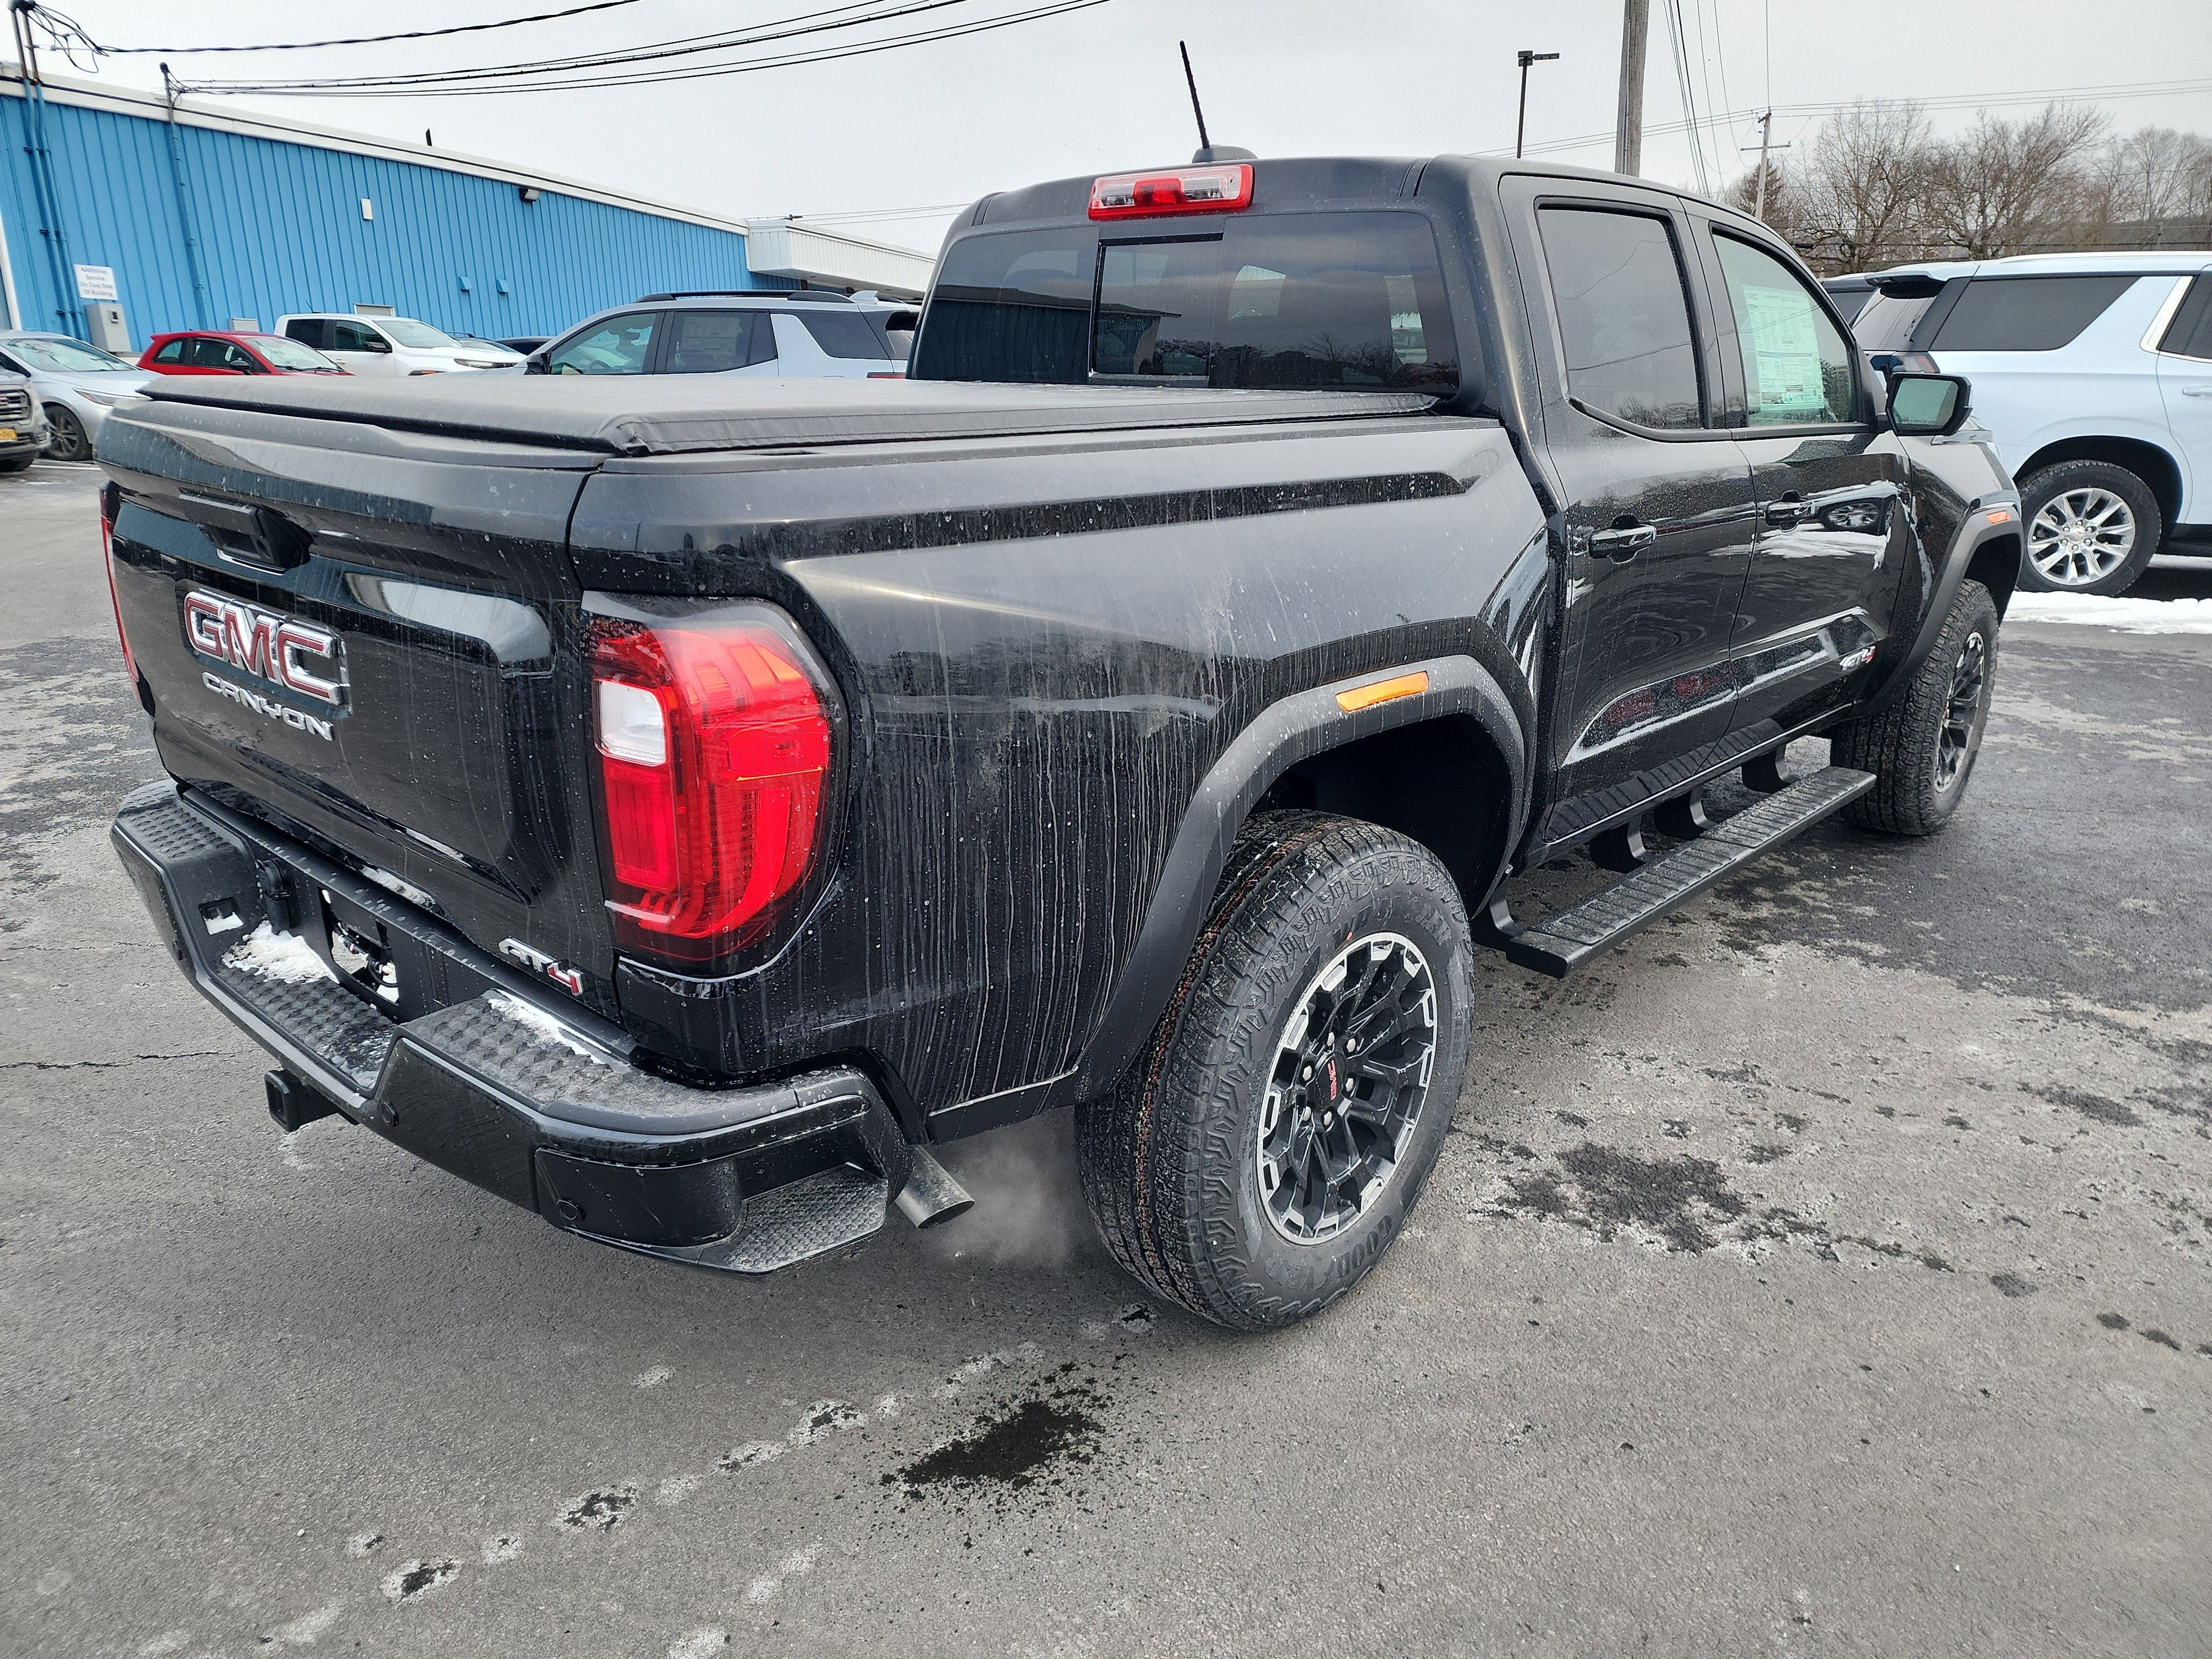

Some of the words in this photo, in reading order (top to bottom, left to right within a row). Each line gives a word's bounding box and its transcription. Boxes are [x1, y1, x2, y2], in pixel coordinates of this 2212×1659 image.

[184, 591, 345, 706] GMC
[202, 671, 335, 741] CANYON
[498, 937, 582, 997] AT4
[1327, 1059, 1337, 1101] GMC
[1265, 1215, 1392, 1292] GOODYEAR
